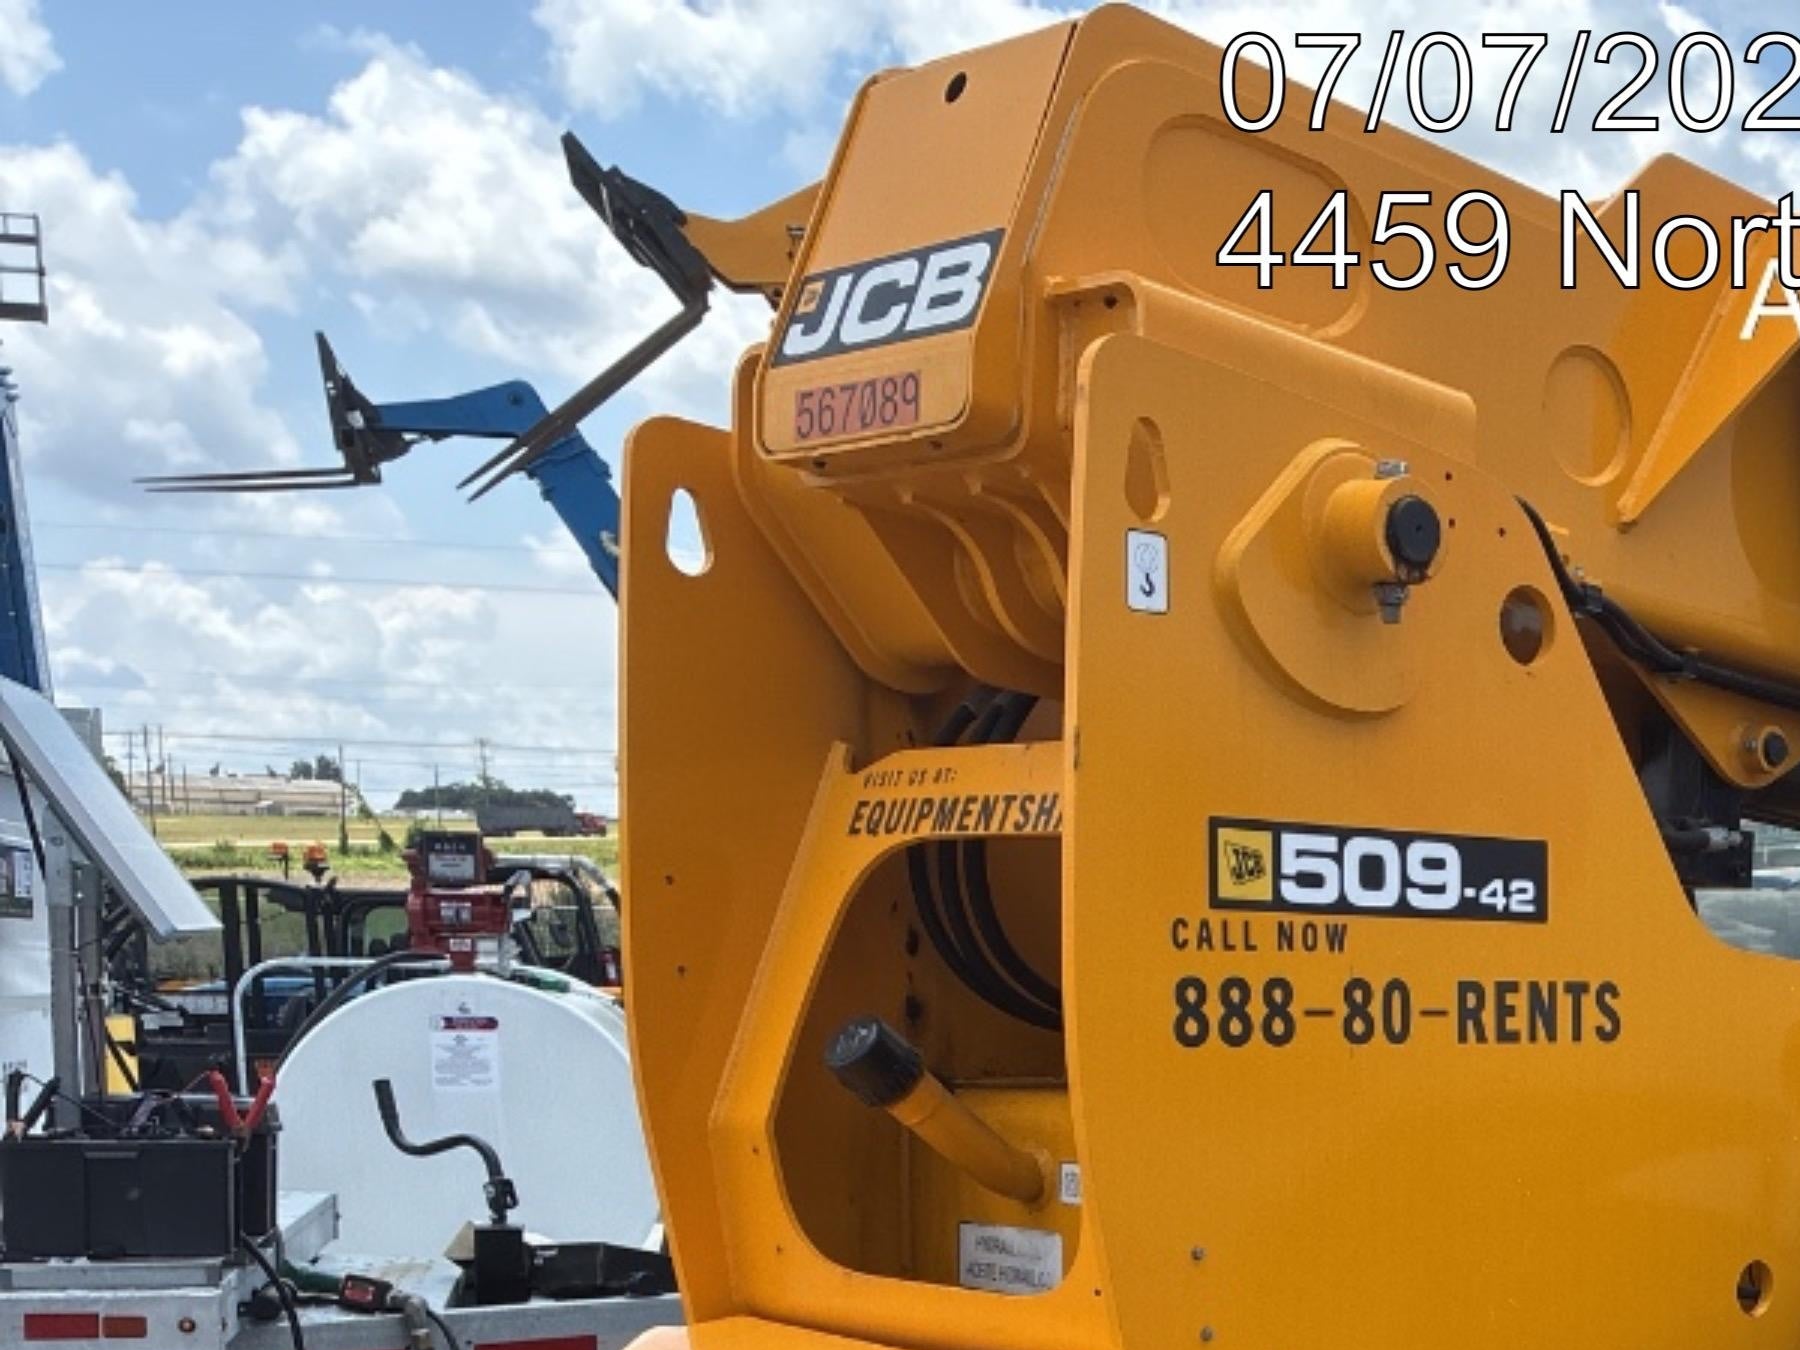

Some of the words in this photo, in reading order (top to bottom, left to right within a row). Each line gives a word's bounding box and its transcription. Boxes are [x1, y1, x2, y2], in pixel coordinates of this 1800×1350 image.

[782, 241, 992, 356] JCB
[795, 371, 920, 440] 567089
[1279, 831, 1538, 913] 509-42
[1171, 917, 1258, 952] CALL
[1277, 920, 1349, 953] NOW
[1173, 976, 1622, 1048] 888-80-RENTS
